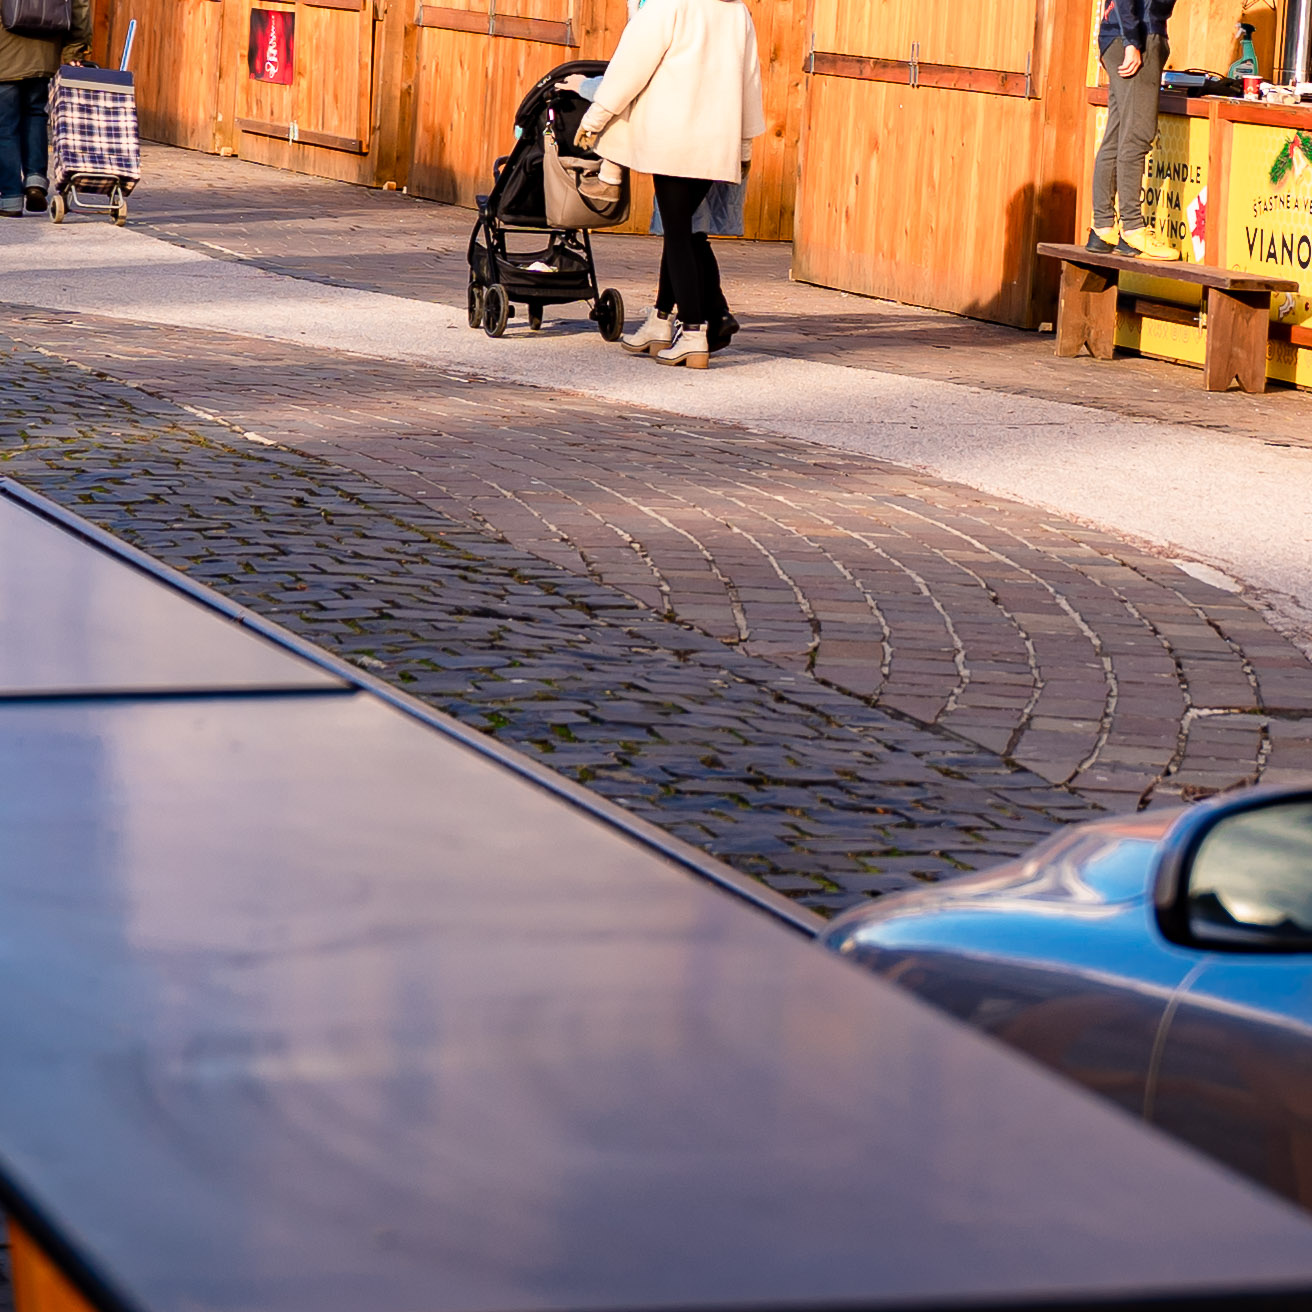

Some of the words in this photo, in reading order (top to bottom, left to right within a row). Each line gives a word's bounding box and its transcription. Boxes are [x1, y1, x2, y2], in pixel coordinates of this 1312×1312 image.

[1156, 161, 1201, 184] MANDLE
[1139, 187, 1181, 211] DOVINA
[1252, 189, 1290, 218] ŠŤASTNÉ
[1294, 198, 1299, 209] A
[1159, 214, 1187, 240] VÍNO
